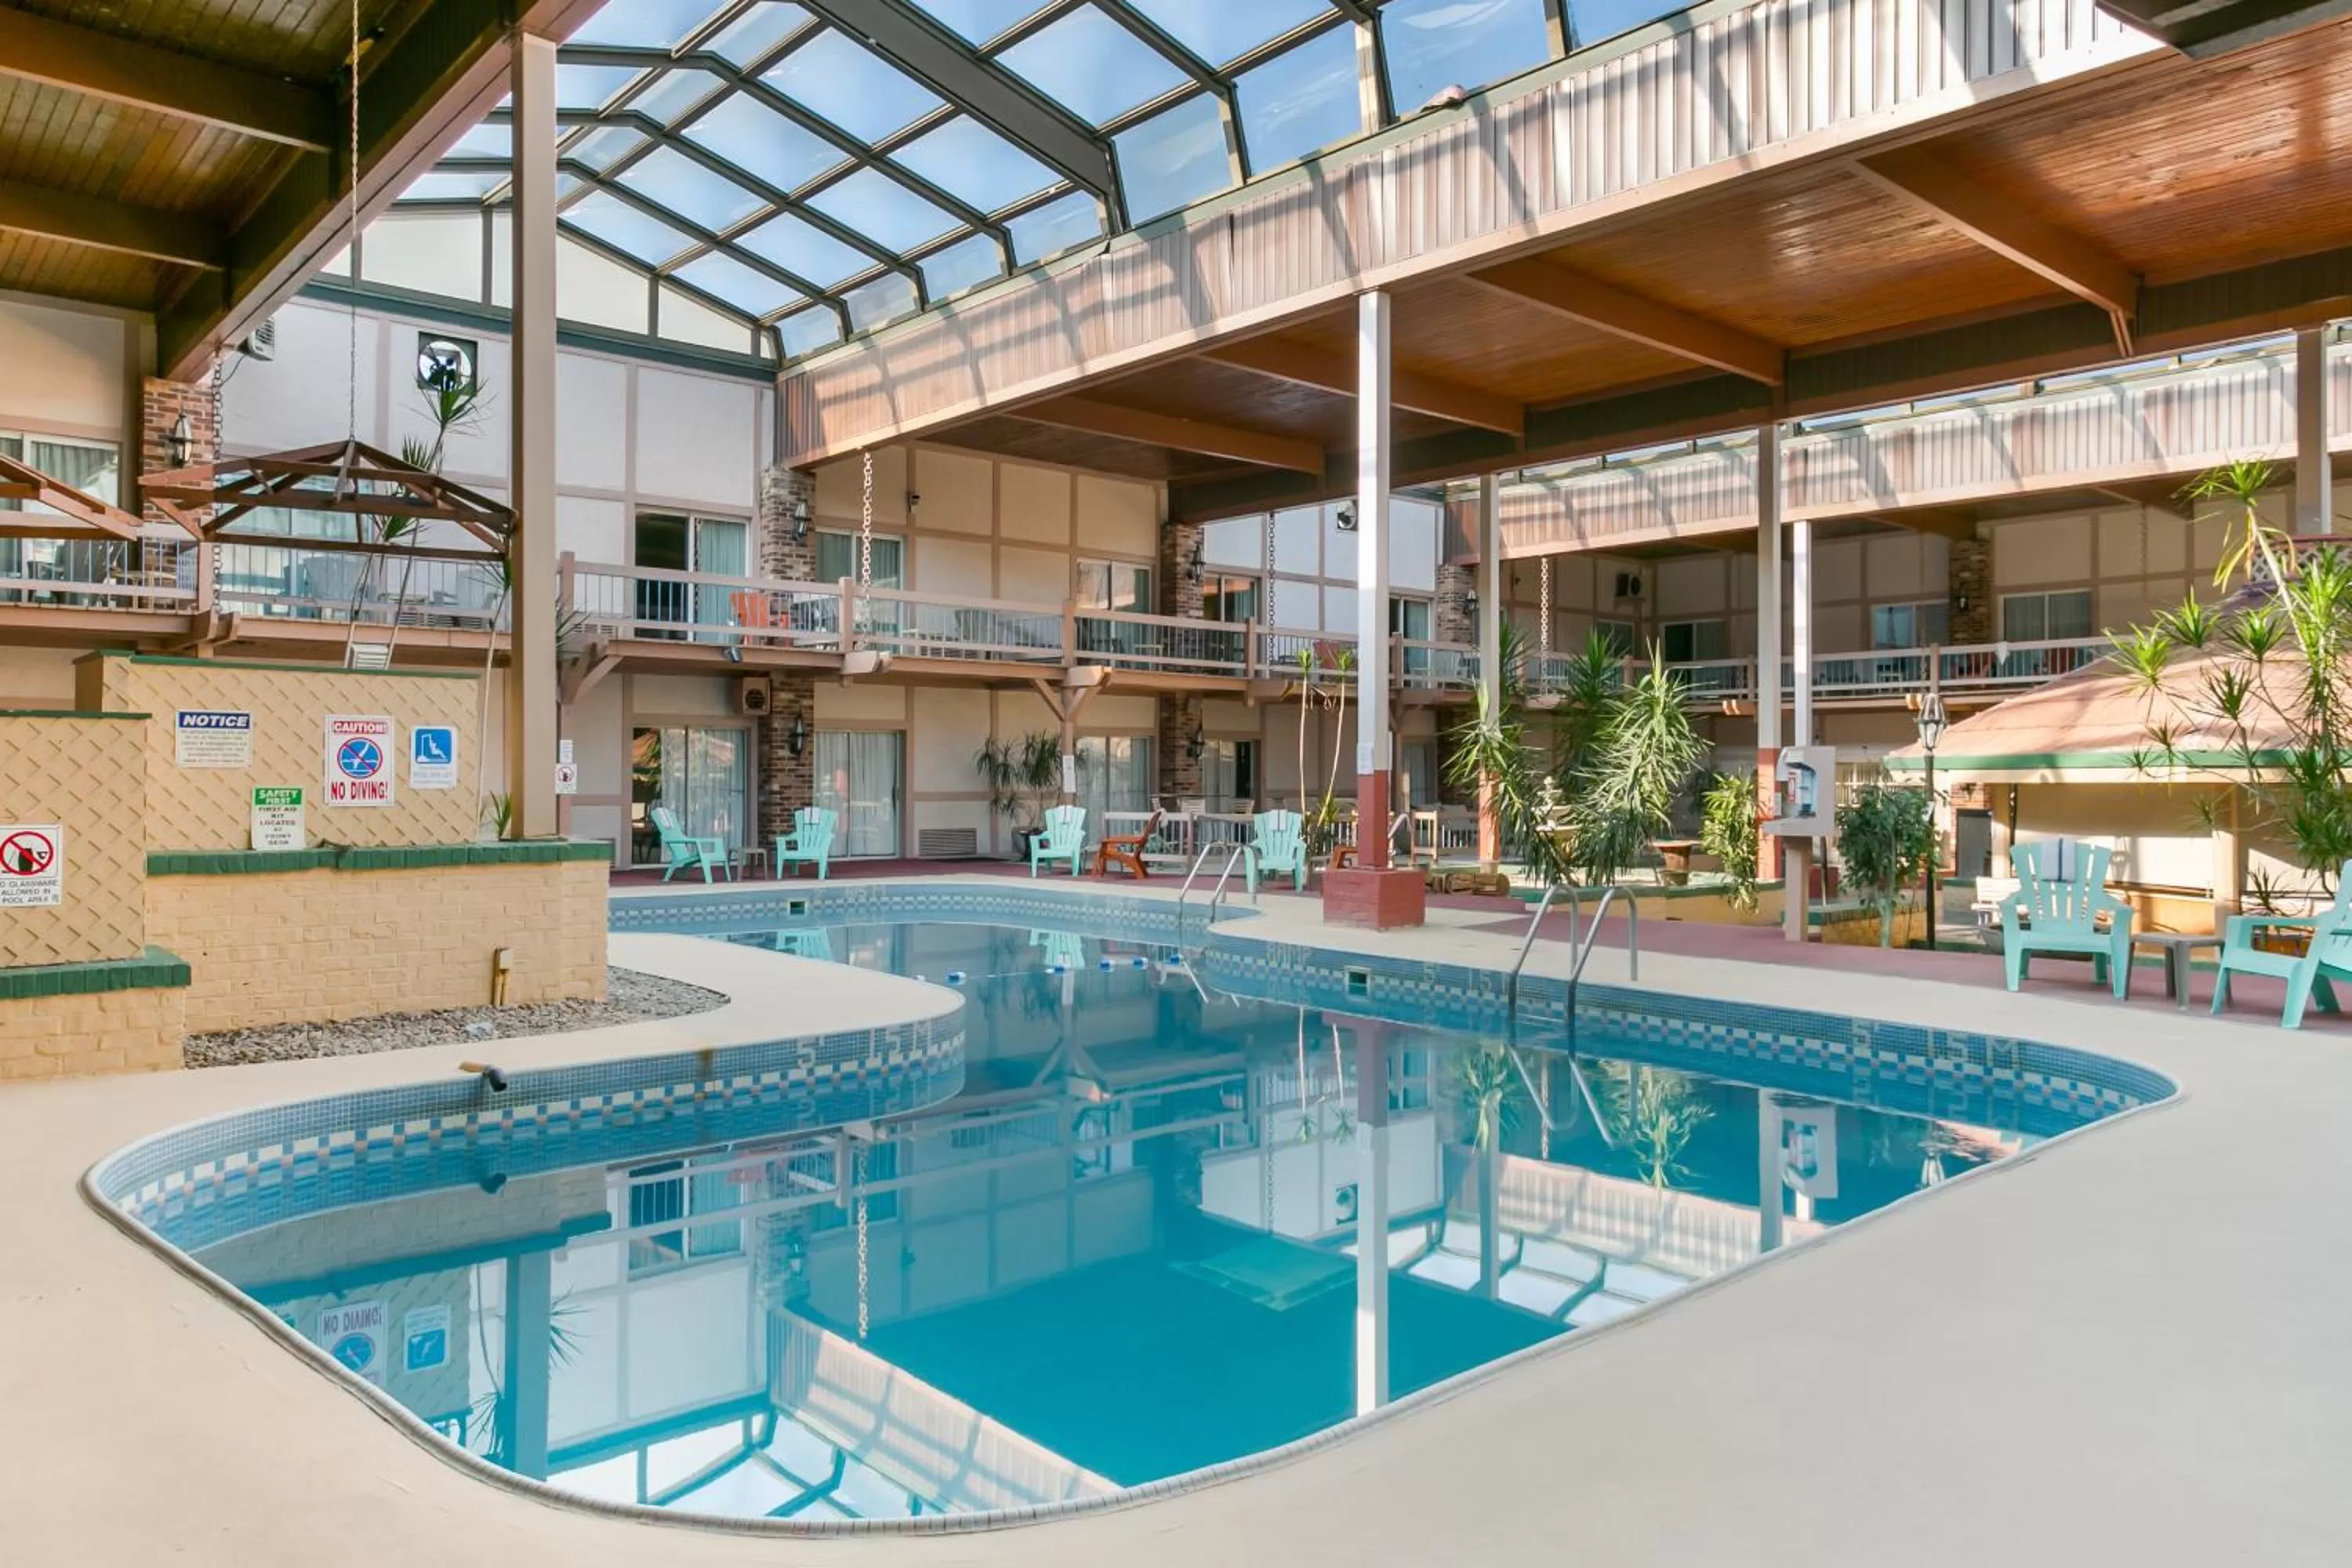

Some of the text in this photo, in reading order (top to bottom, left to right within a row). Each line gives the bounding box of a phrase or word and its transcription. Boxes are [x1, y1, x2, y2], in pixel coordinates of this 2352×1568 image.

[183, 714, 249, 727] NOTICE
[334, 722, 387, 733] CAUTION!
[259, 789, 299, 798] SAFETY
[331, 781, 388, 800] NO DIVING!
[1985, 1034, 2020, 1072] M
